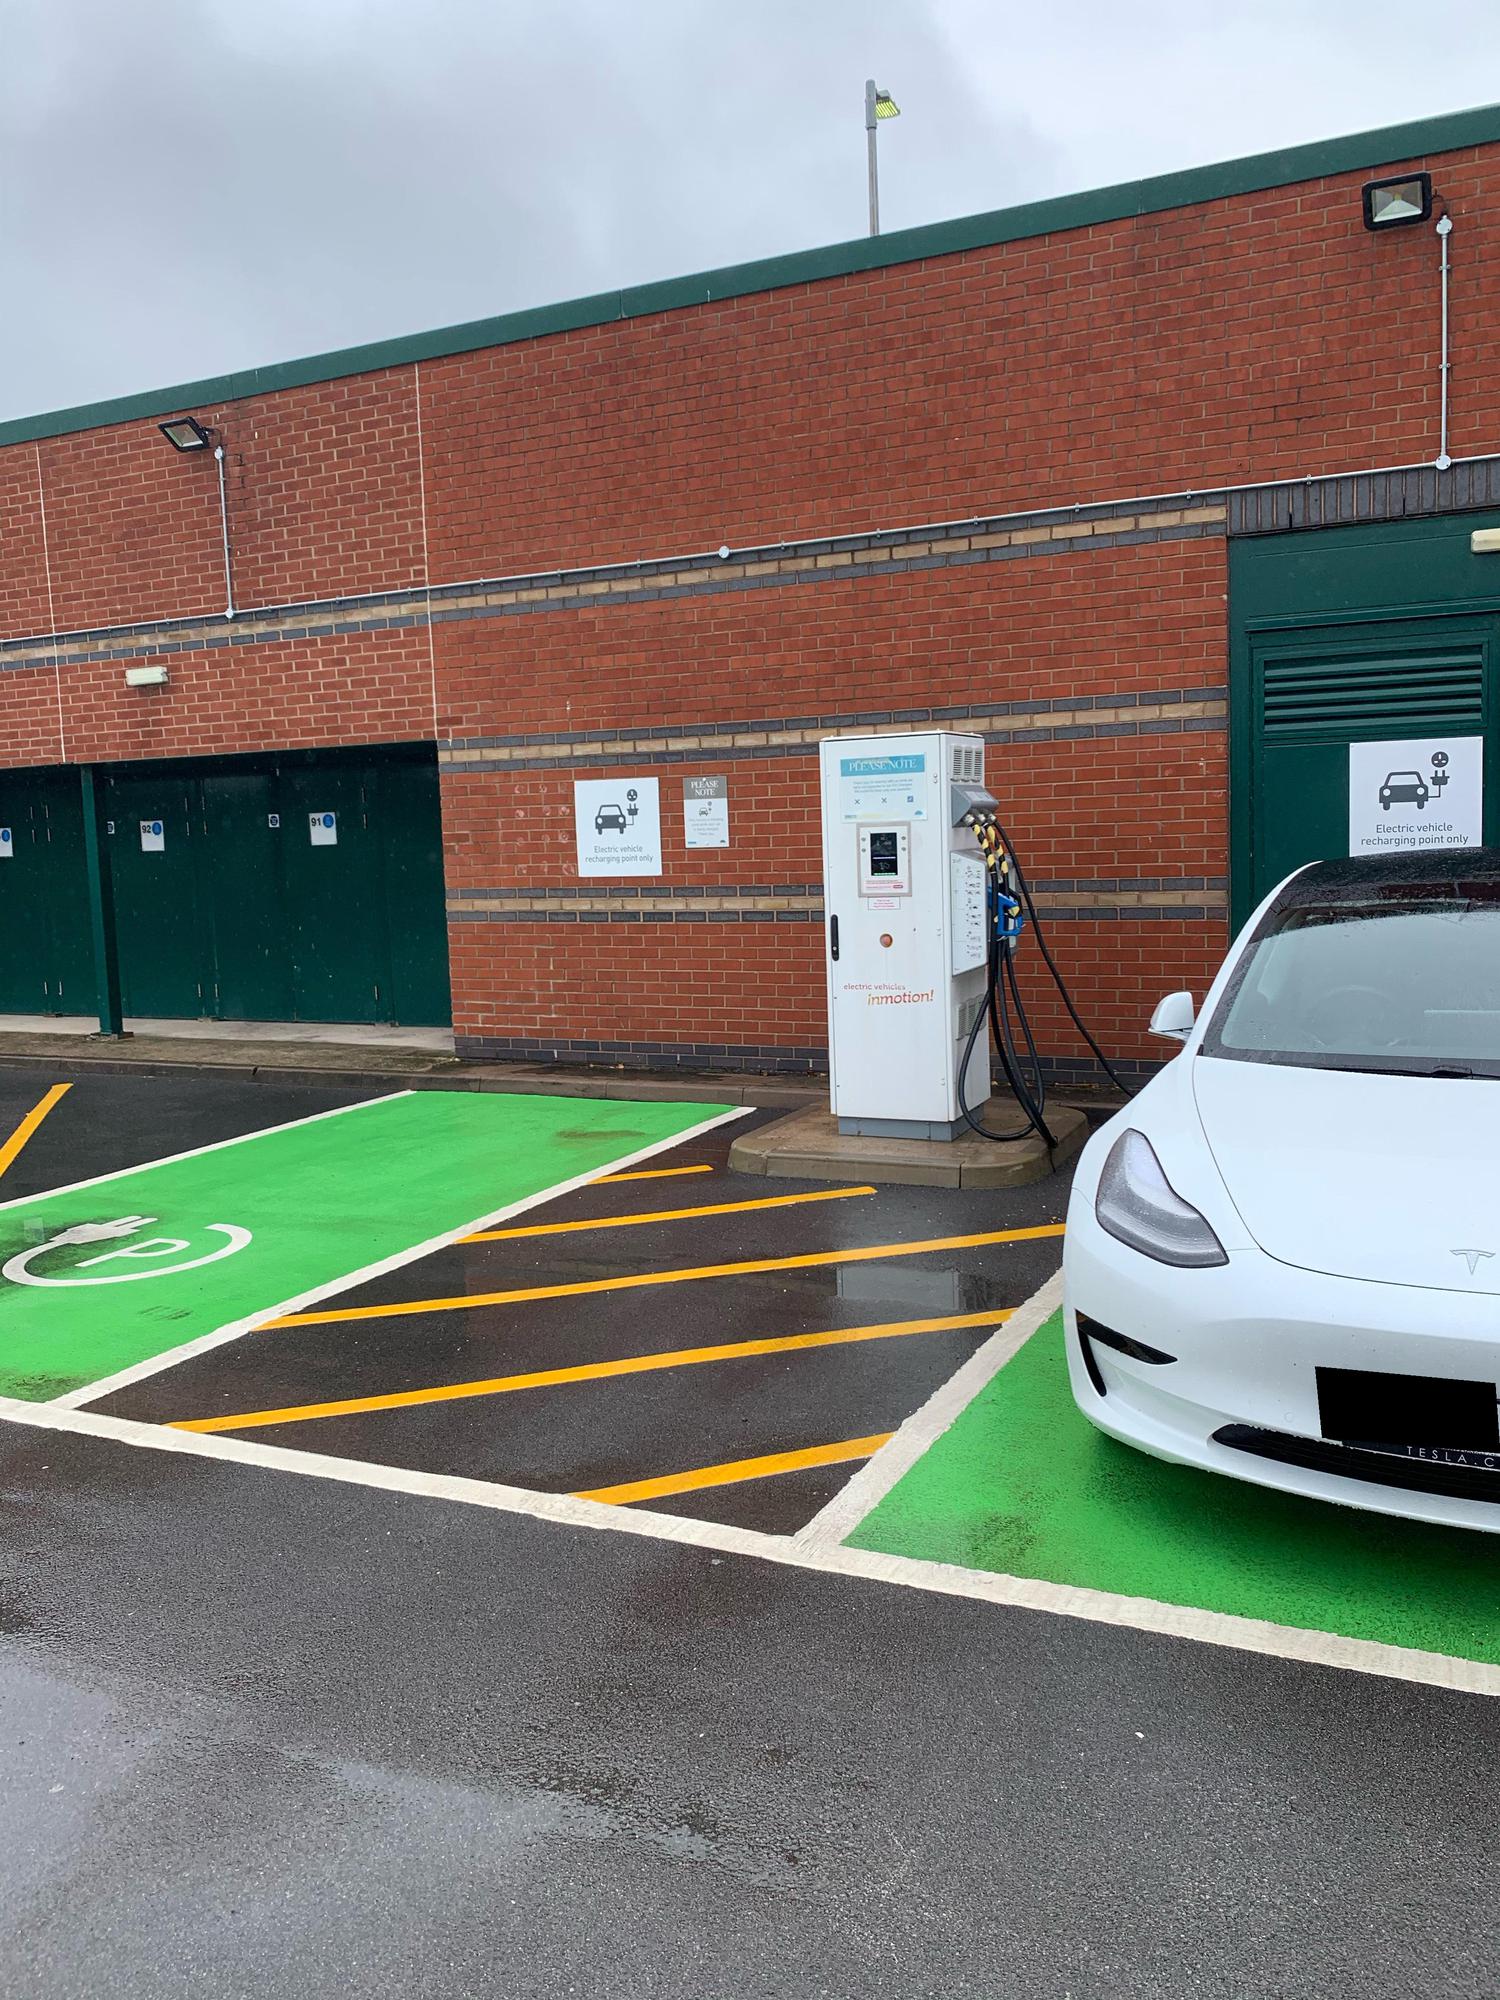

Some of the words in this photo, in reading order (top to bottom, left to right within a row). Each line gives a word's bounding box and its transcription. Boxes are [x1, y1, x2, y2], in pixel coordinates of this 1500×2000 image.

[848, 761, 888, 772] PLEASE
[889, 759, 917, 769] NOTE
[690, 780, 719, 789] PLEASE
[695, 788, 716, 796] NOTE
[311, 817, 321, 826] 91
[141, 825, 151, 833] 92
[1376, 824, 1415, 833] Electric
[1416, 822, 1453, 832] vehicle
[1361, 836, 1416, 847] recharging
[1418, 834, 1444, 846] point
[1446, 834, 1469, 845] only
[593, 845, 619, 853] Electric
[620, 844, 643, 852] vehicle
[585, 856, 620, 864] recharging
[621, 855, 638, 863] point
[639, 854, 654, 863] only
[867, 989, 934, 1005] inmotion!
